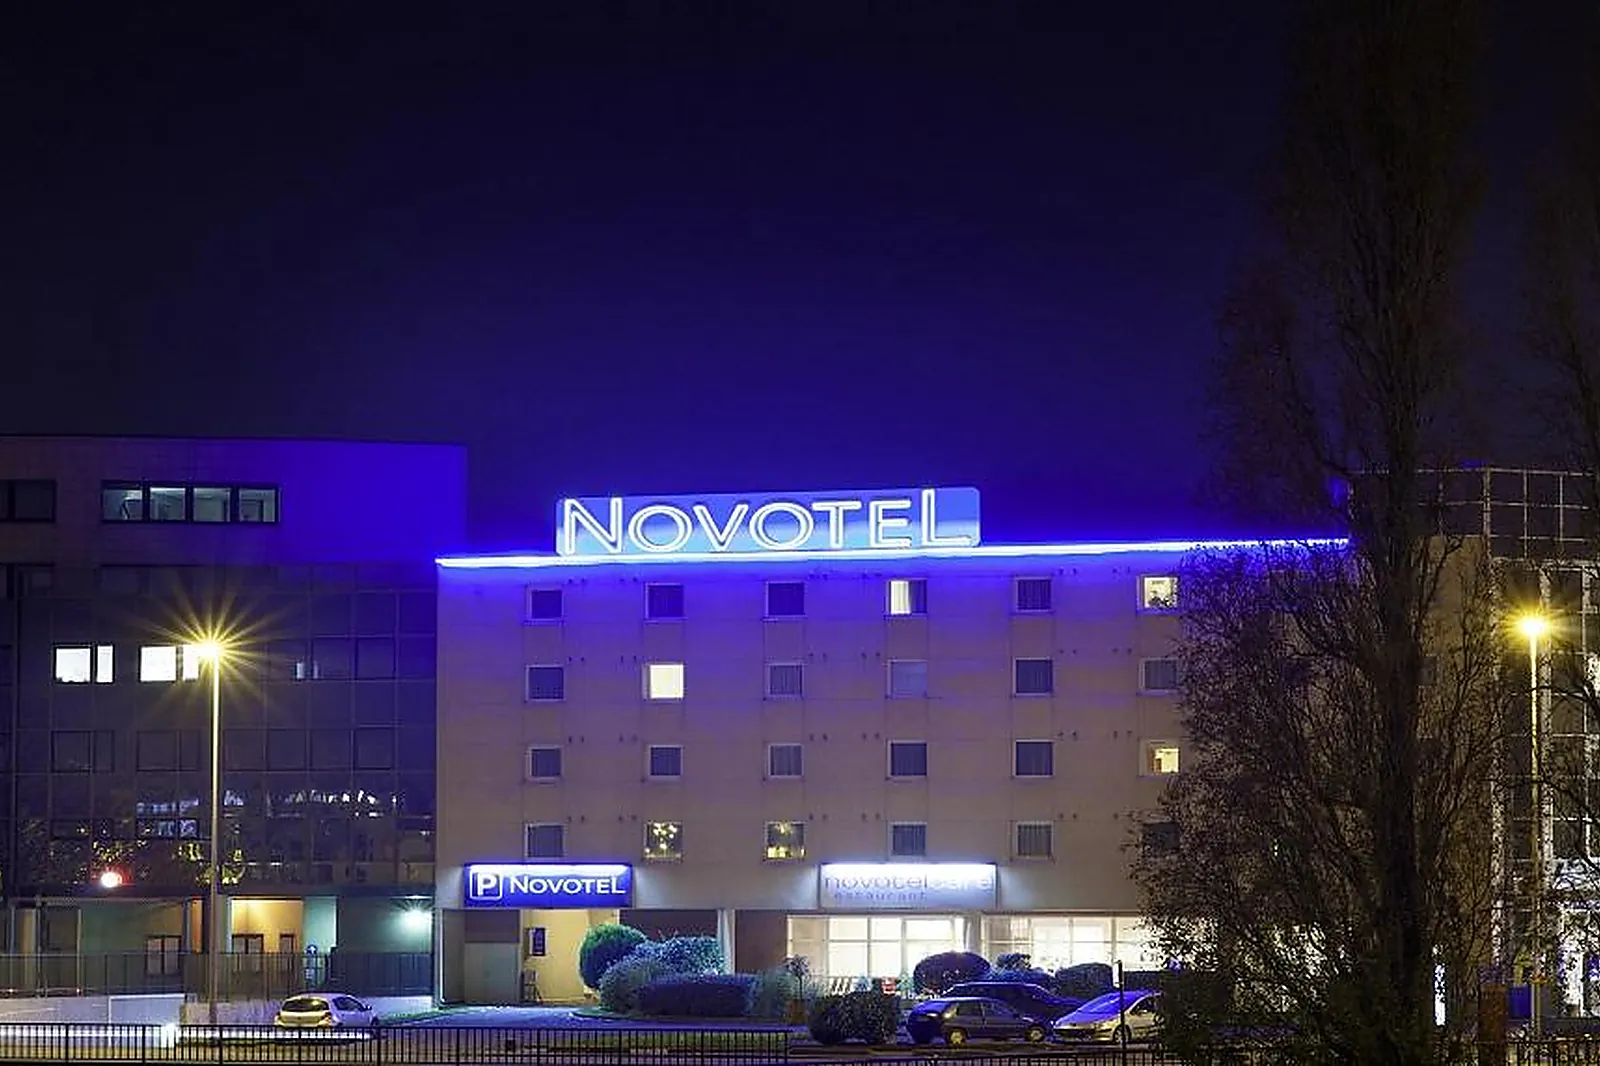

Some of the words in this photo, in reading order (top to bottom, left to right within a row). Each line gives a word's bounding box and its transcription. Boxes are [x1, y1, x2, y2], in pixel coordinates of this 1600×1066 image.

[563, 488, 972, 554] NOVOTEL
[477, 872, 497, 896] P
[510, 876, 626, 894] NOVOTEL
[828, 889, 927, 902] estaurant
